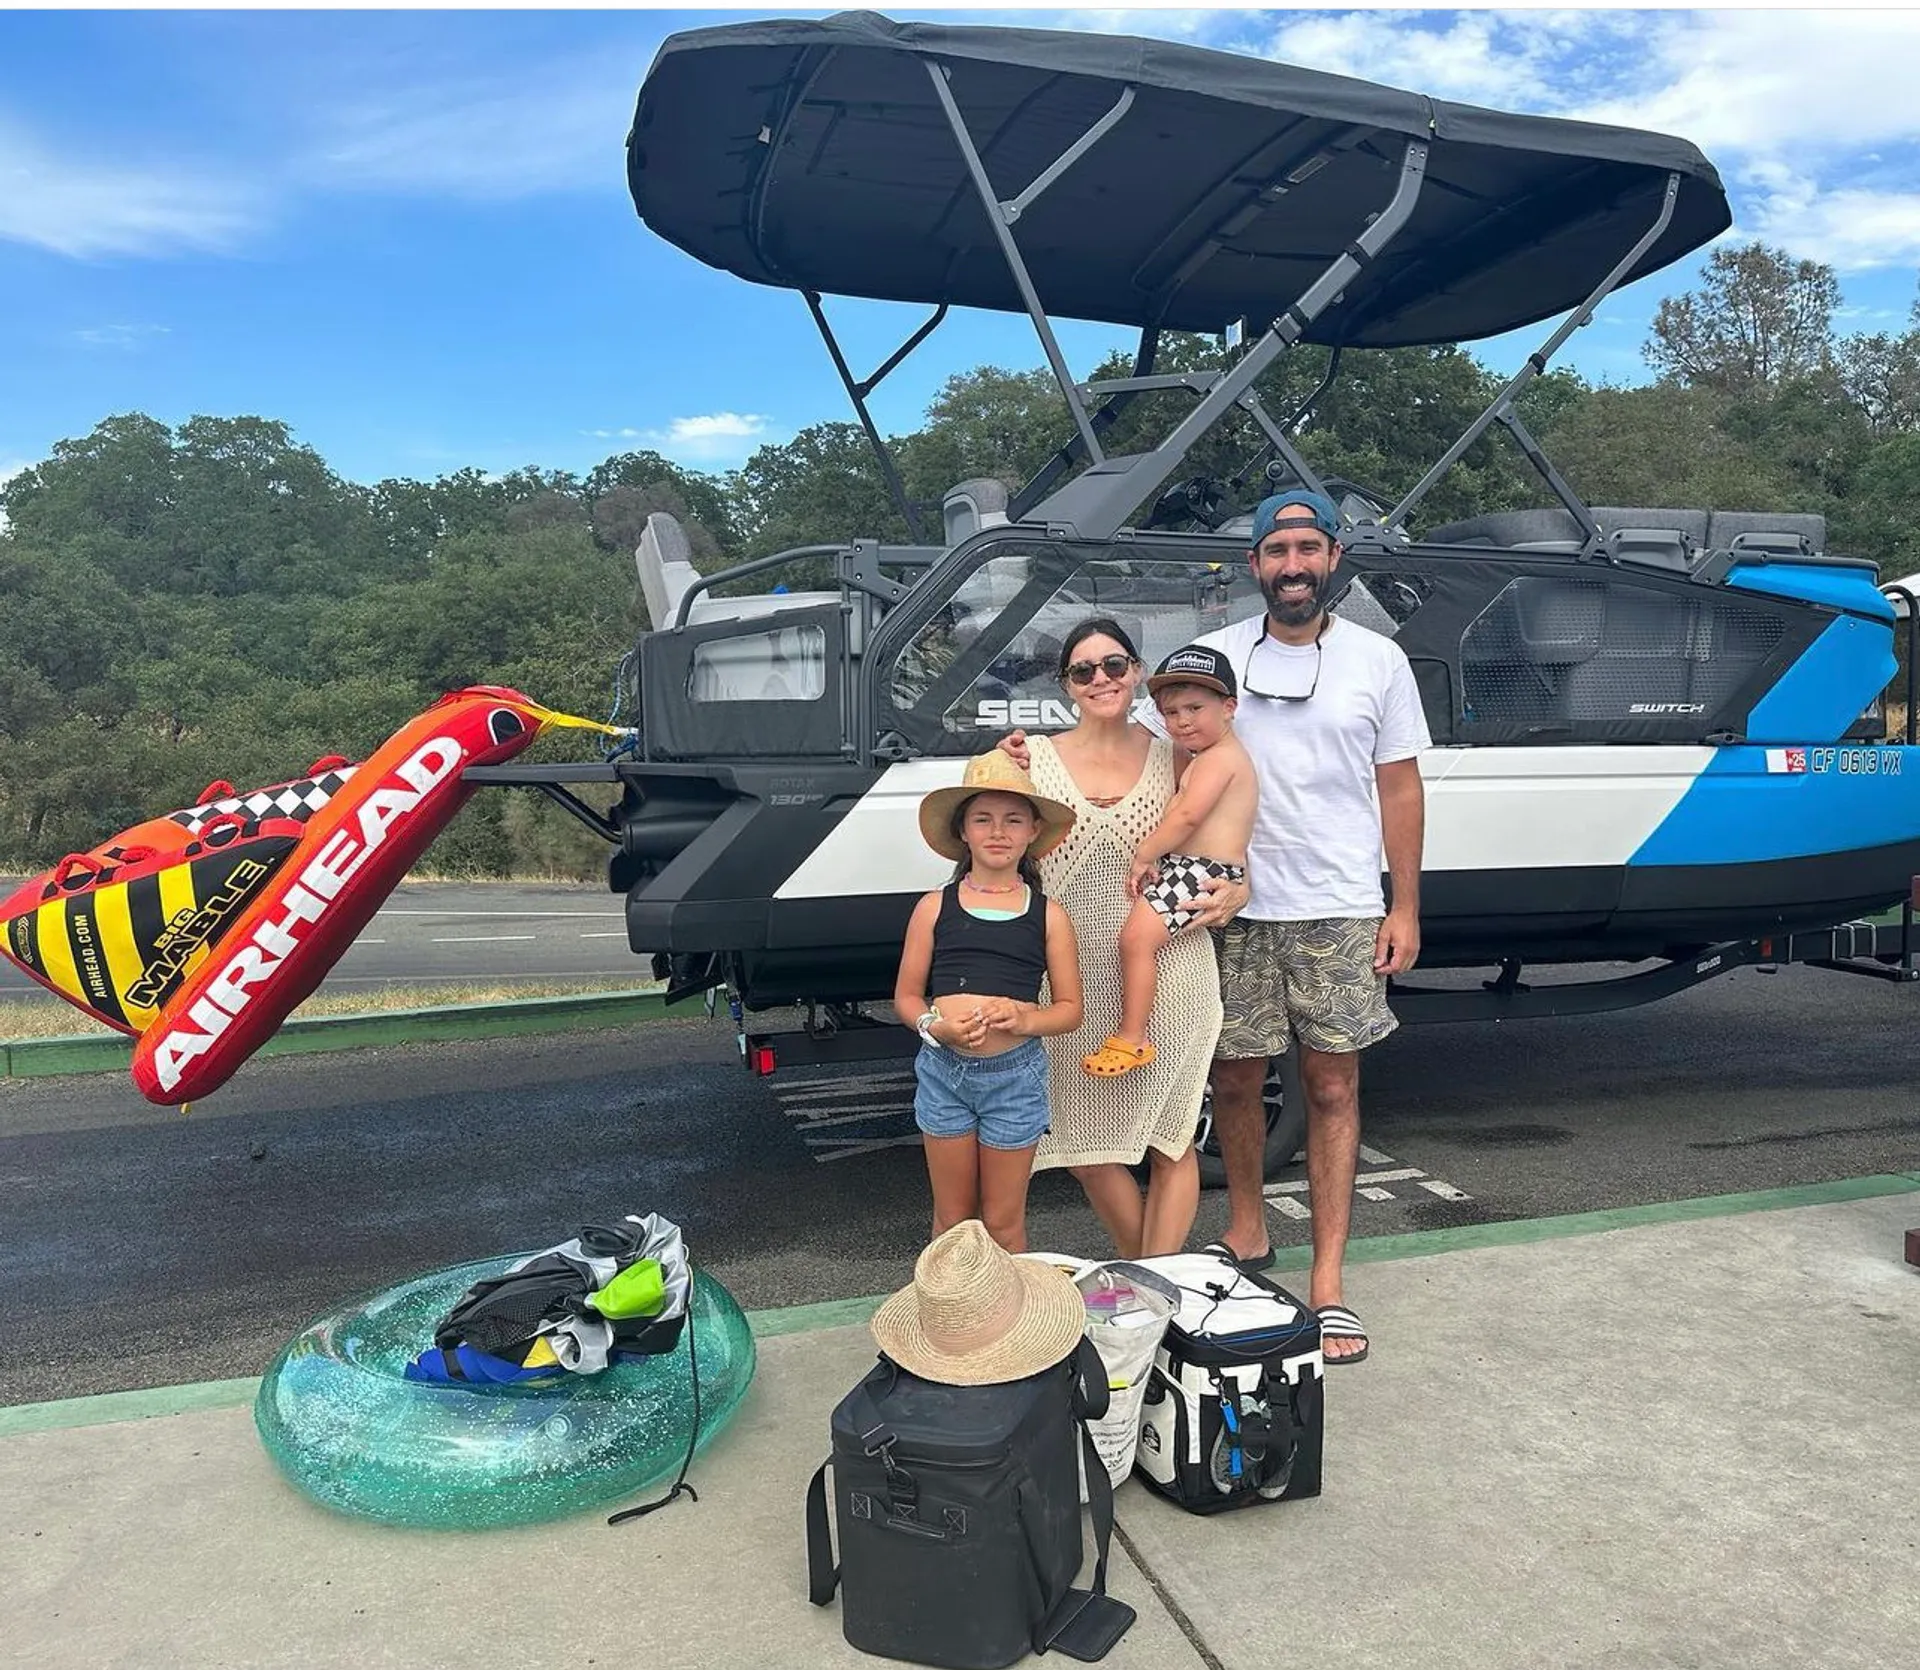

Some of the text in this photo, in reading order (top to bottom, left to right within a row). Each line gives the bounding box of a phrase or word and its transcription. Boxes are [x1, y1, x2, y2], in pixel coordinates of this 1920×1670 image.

[1629, 703, 1705, 713] SWITCH
[1812, 748, 1836, 773] CF
[1838, 749, 1880, 775] 0613
[124, 858, 268, 1009] MABLE
[152, 735, 463, 1093] AIRHEAD
[153, 907, 198, 950] BIG
[73, 914, 108, 999] AIRHEAD.COM
